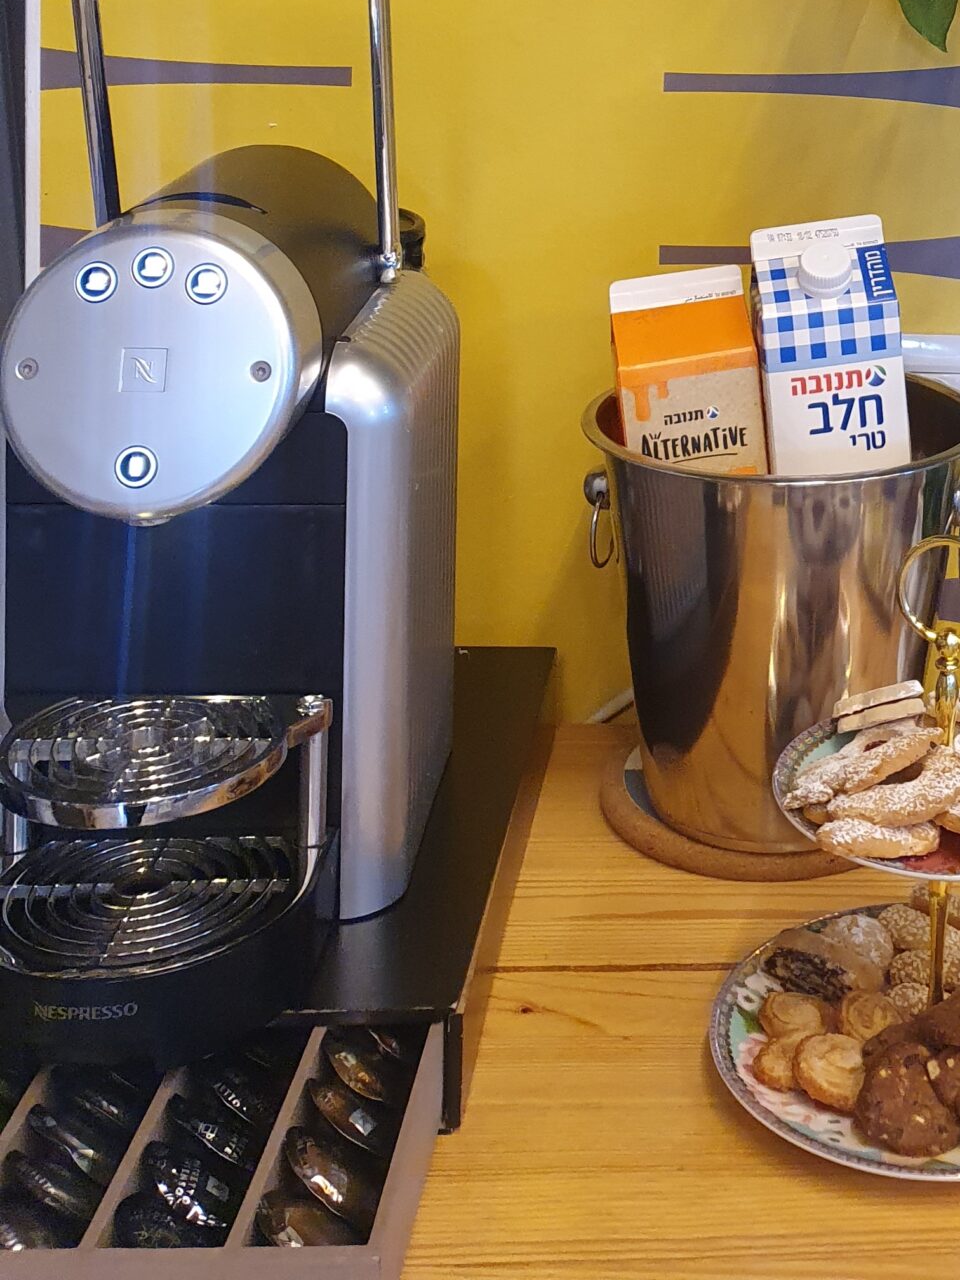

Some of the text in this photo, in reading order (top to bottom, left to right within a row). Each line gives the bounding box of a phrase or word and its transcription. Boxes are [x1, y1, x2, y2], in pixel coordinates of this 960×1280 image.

[864, 249, 894, 298] מהדרין
[790, 367, 864, 397] תנובה
[663, 408, 704, 426] תנובה
[807, 392, 885, 436] חלב
[641, 425, 748, 461] ALTERNATIVE
[849, 431, 887, 452] טרי
[33, 1000, 139, 1022] NESPRESSO
